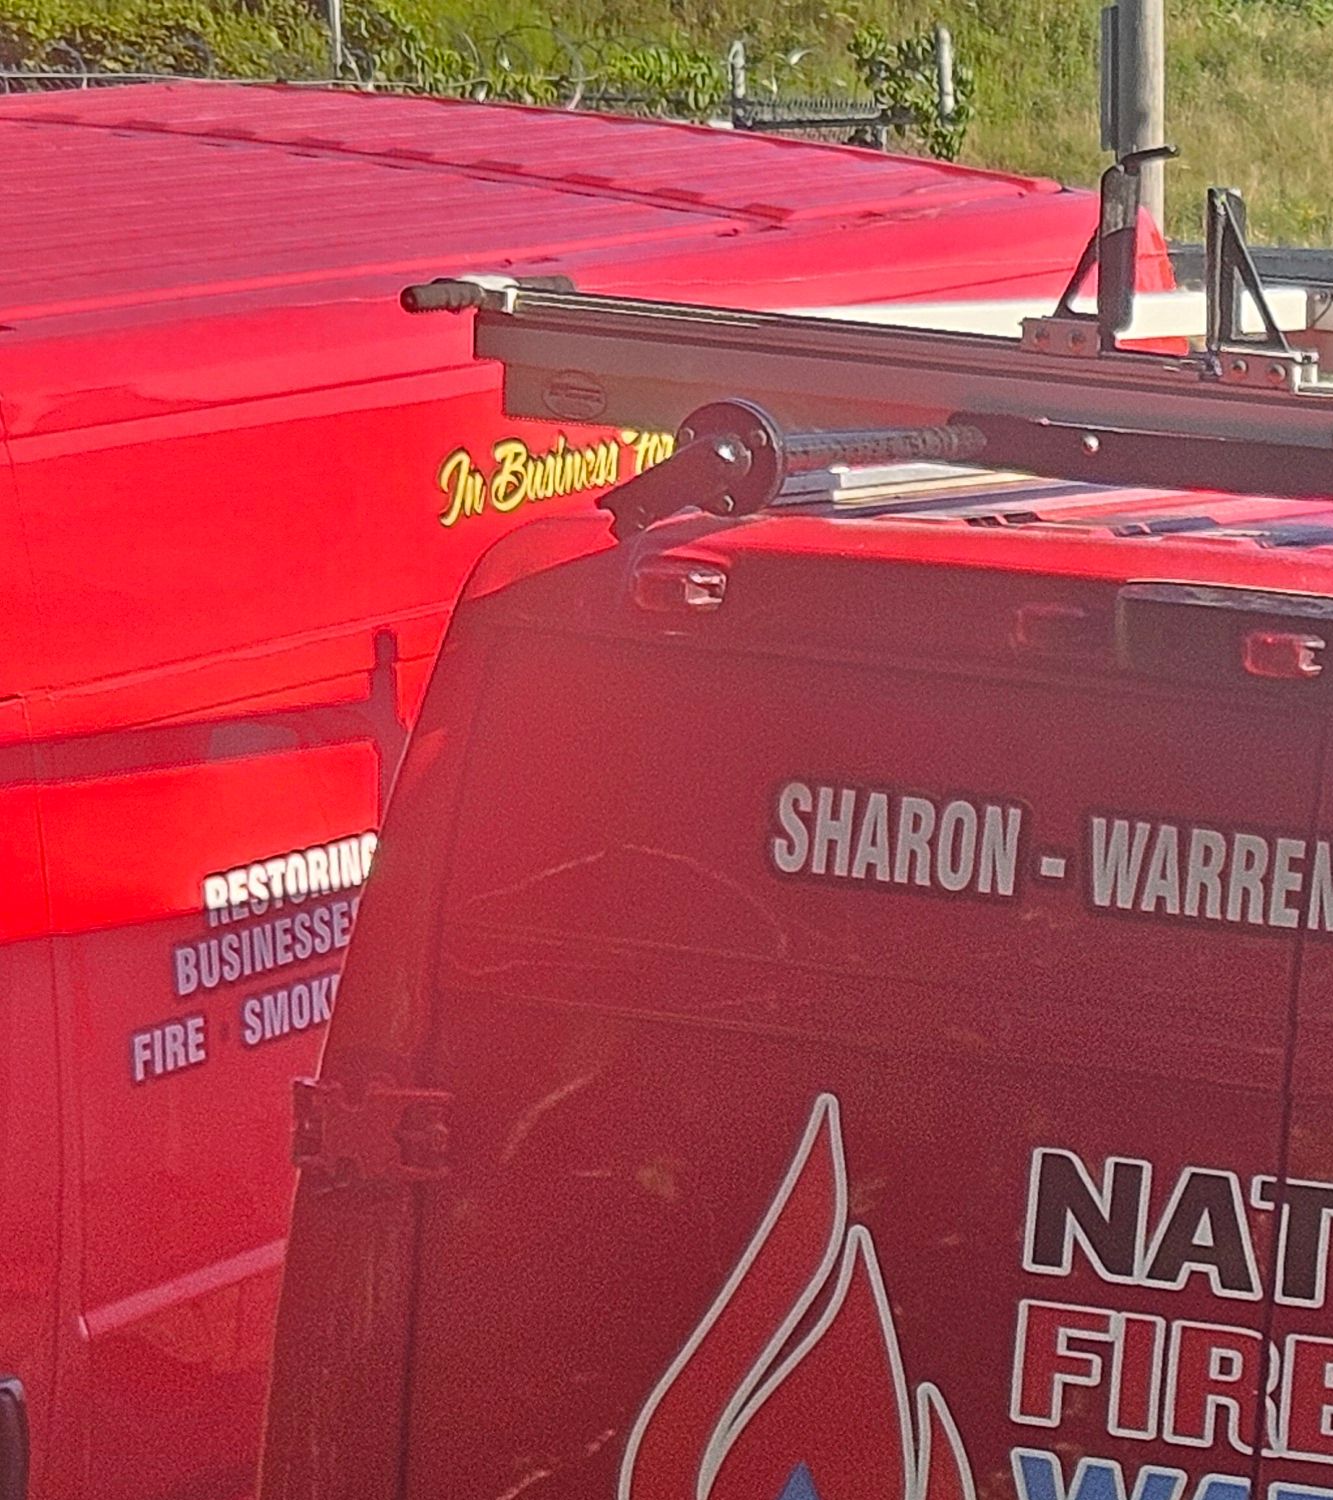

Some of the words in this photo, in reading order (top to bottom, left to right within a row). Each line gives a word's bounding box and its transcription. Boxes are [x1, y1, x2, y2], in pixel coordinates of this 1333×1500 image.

[440, 450, 485, 527] In
[490, 434, 620, 512] Business
[772, 782, 1022, 896] SHARON
[174, 897, 360, 997] BUSINESSE
[133, 1016, 206, 1083] FIRE
